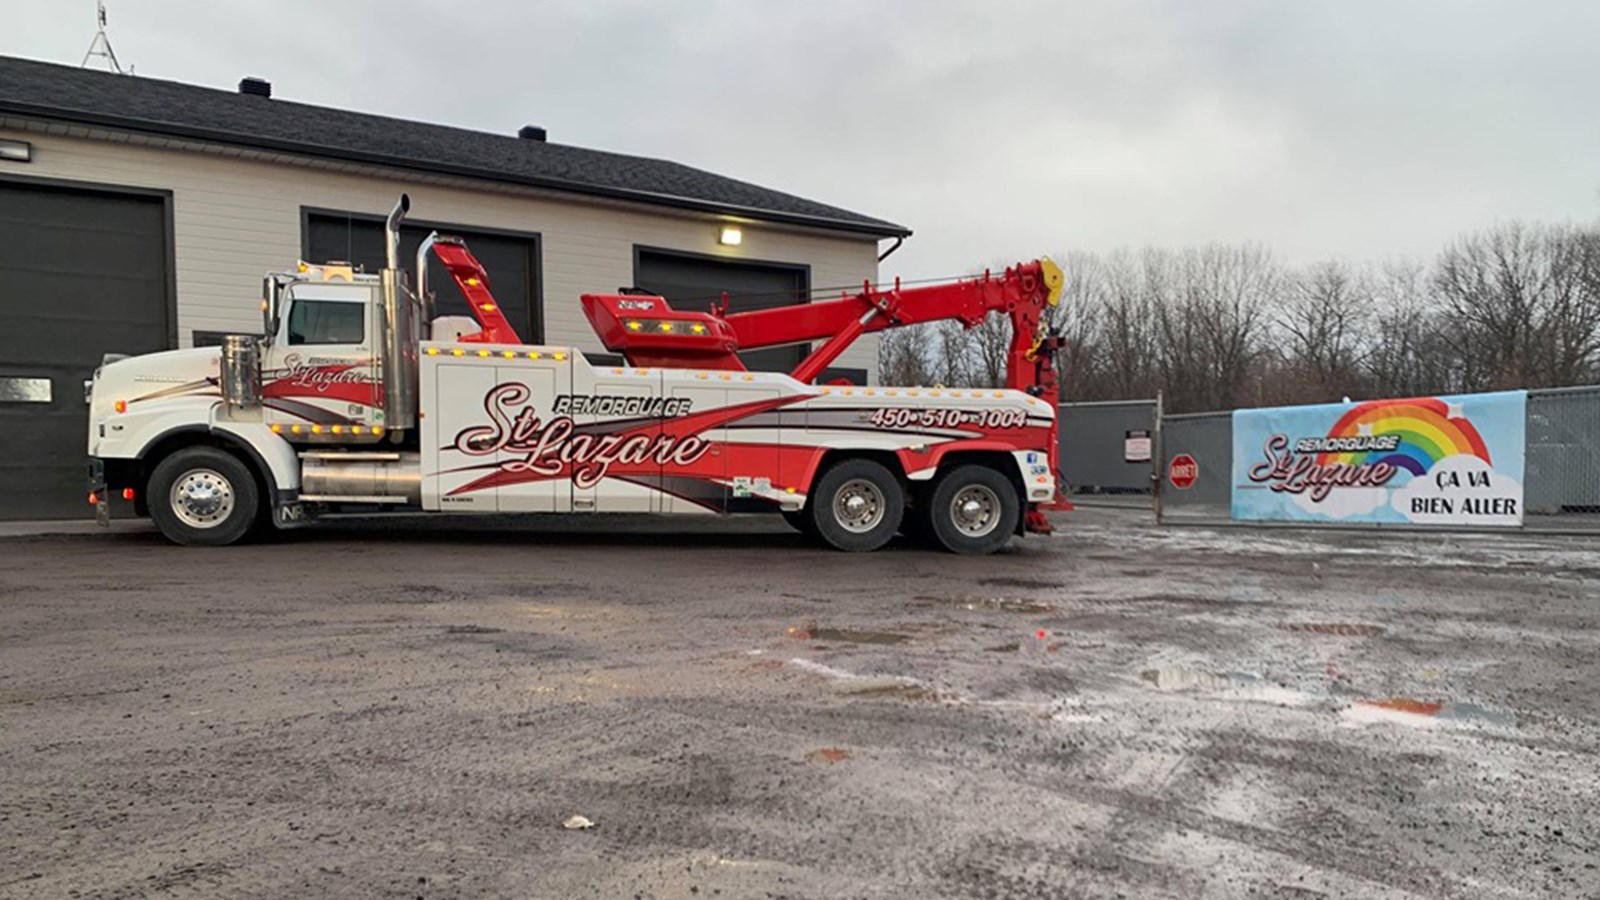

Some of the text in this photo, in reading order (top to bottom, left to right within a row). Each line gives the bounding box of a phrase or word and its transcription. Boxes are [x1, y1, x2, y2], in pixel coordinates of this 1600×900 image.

[552, 395, 692, 417] REMORQUAGE
[500, 416, 709, 490] Lazare
[1294, 435, 1400, 453] REMORQUAGE
[1269, 453, 1398, 502] Lazare
[1436, 470, 1490, 491] ÇA VA
[1411, 497, 1517, 515] BIEN ALLER
